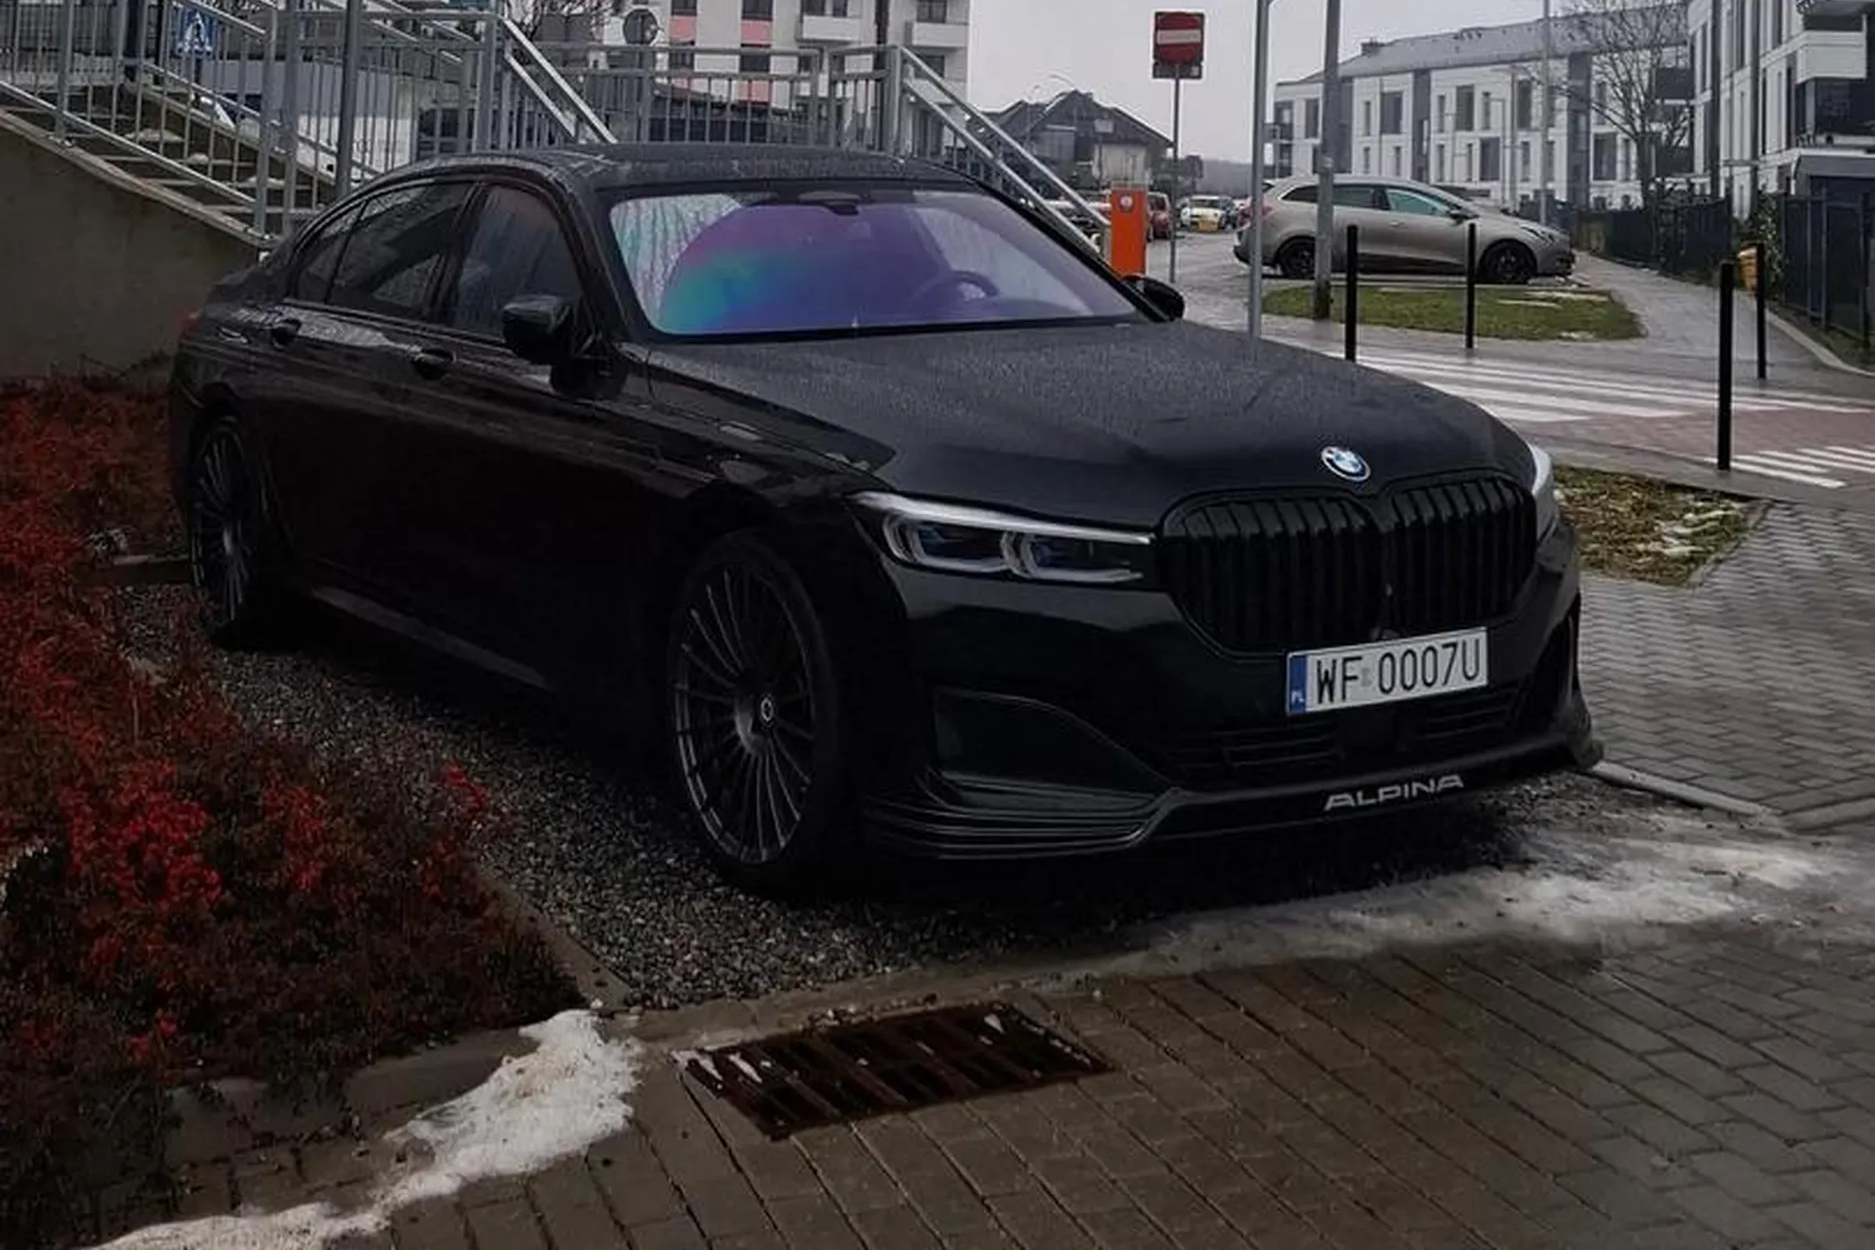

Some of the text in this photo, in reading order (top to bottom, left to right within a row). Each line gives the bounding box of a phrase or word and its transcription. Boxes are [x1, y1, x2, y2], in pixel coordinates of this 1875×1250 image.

[1316, 639, 1480, 704] WF 0007U
[1324, 774, 1464, 811] ALPINA
